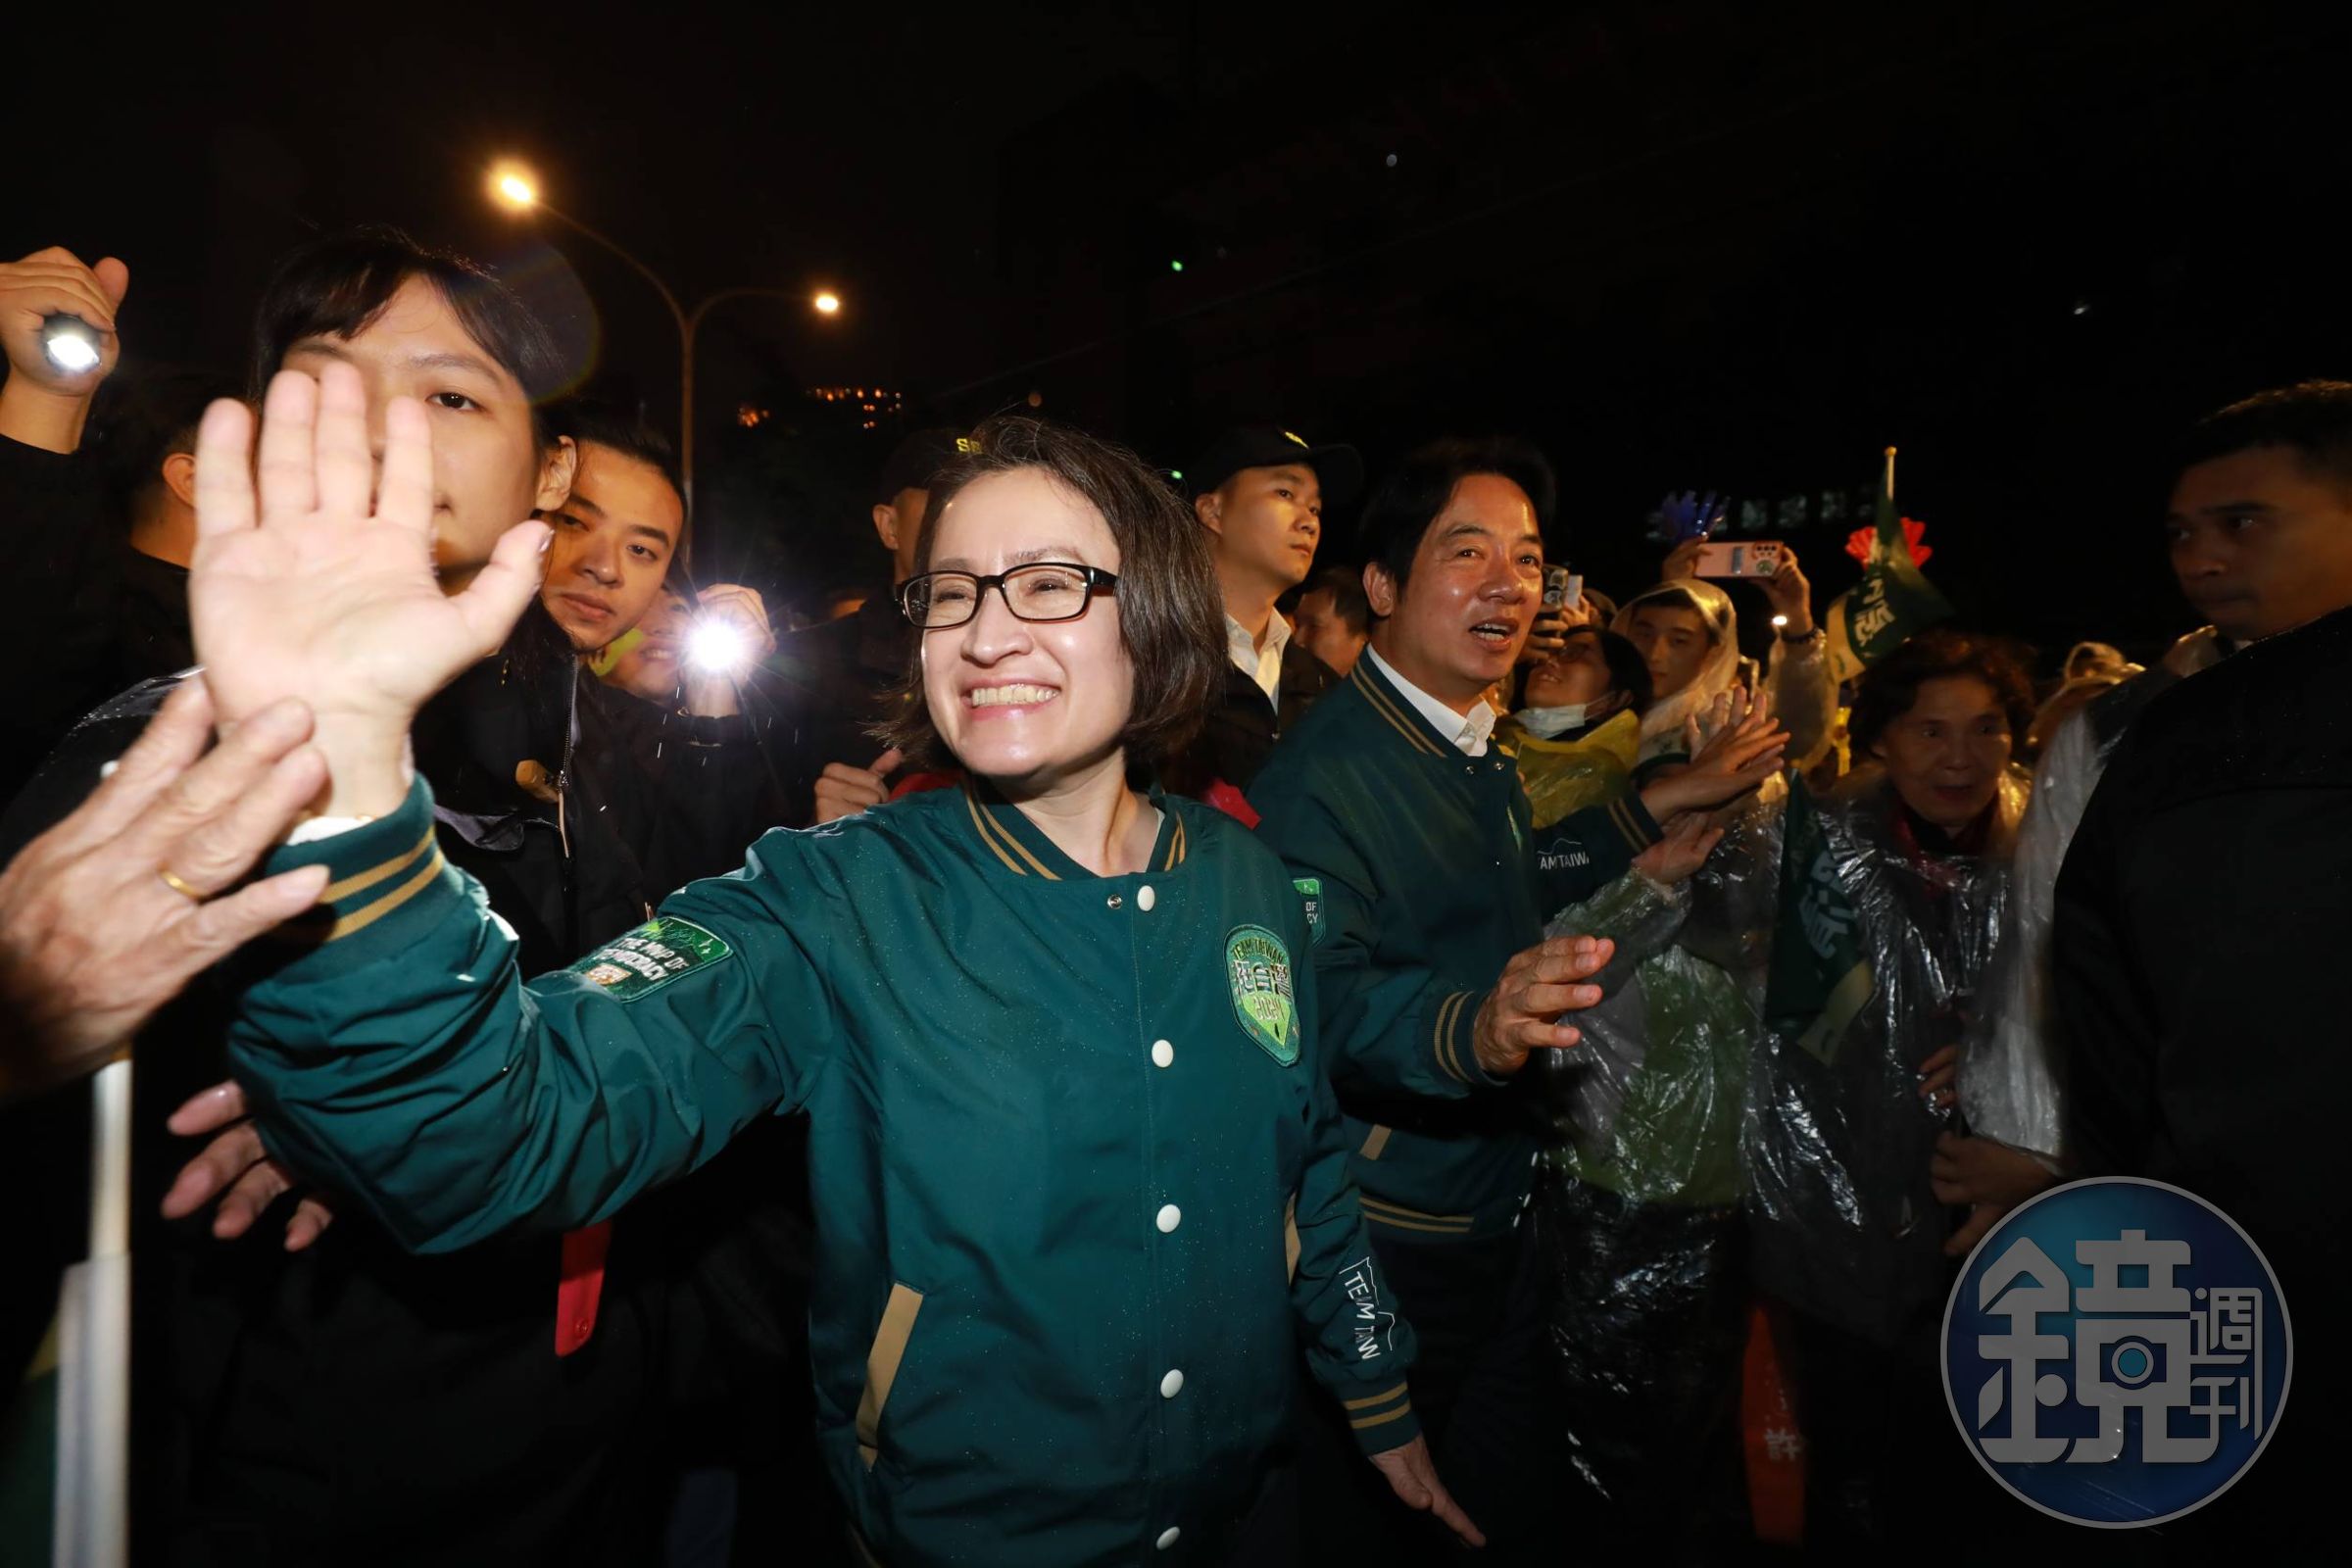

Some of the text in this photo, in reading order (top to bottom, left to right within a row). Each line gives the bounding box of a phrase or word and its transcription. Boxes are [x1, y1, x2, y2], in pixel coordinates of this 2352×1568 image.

[1305, 902, 1317, 911] OF
[1231, 937, 1285, 965] TEAM TAIWAN
[664, 956, 690, 970] OF
